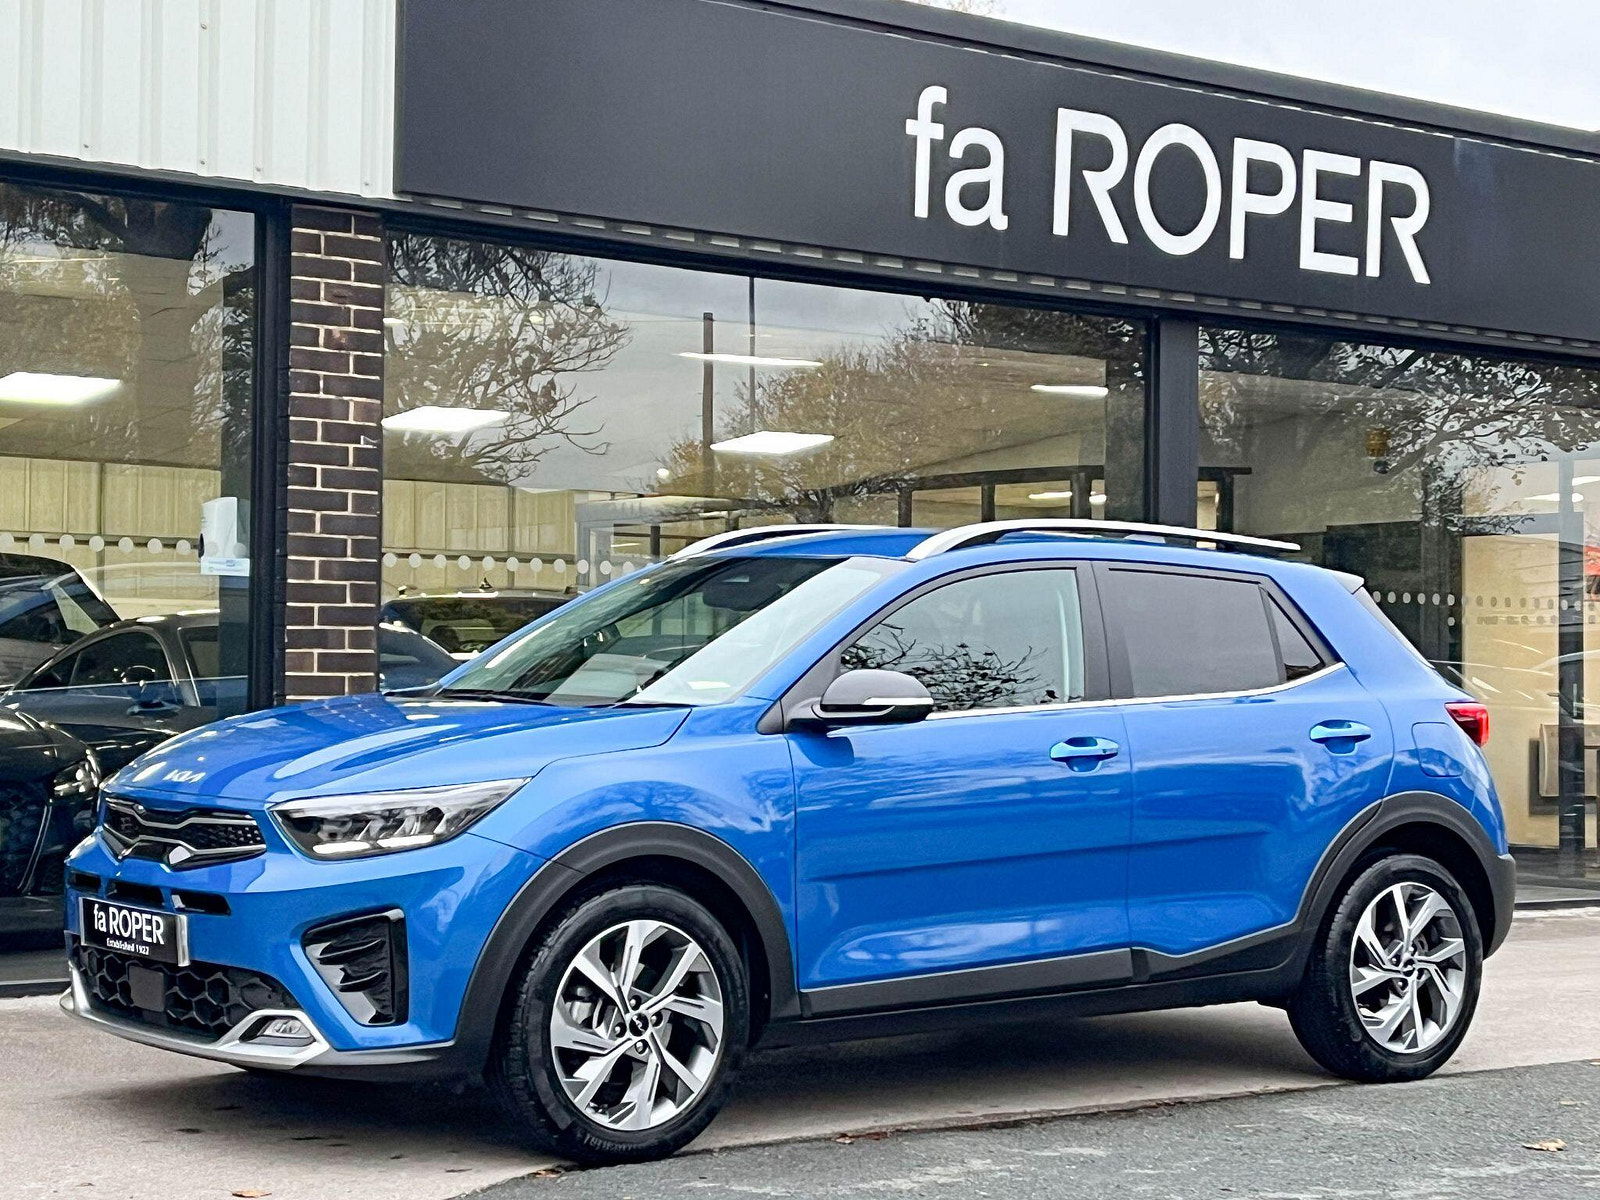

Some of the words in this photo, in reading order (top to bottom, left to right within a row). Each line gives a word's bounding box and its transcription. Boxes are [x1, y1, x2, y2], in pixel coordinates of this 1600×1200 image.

[905, 85, 1009, 231] fa
[1052, 107, 1431, 285] ROPER
[94, 903, 107, 933] fa
[109, 906, 165, 945] ROPER
